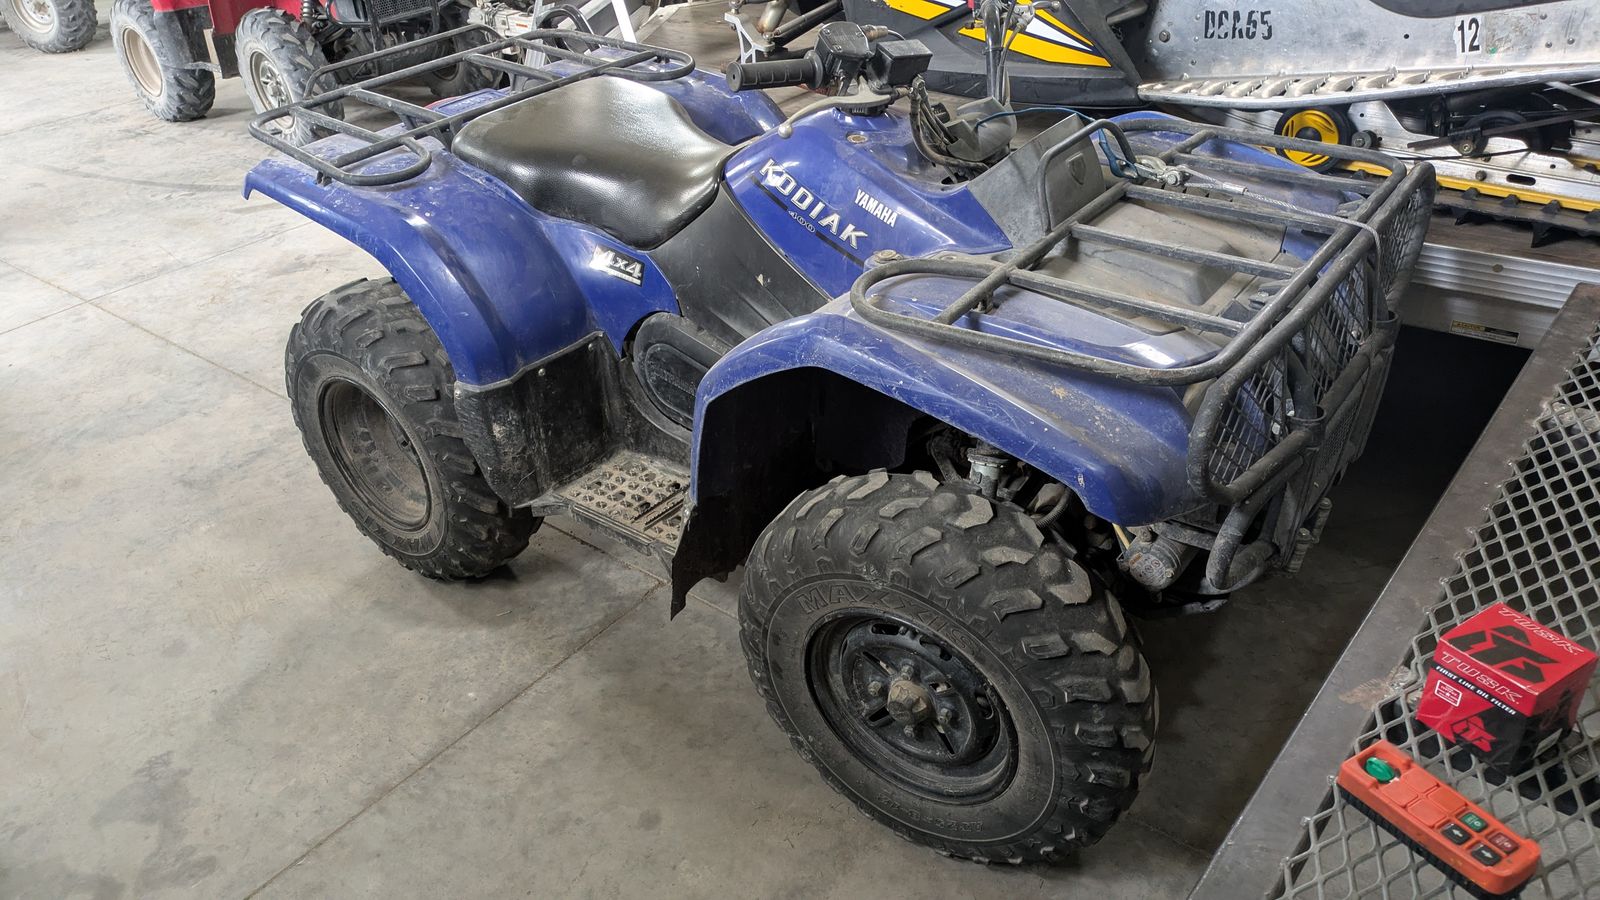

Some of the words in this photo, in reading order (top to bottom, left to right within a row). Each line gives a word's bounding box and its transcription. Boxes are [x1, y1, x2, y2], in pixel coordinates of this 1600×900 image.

[1457, 17, 1480, 53] 12
[759, 158, 869, 250] KODIAK
[787, 210, 816, 233] 400
[854, 188, 898, 228] YAMAHA
[797, 583, 975, 655] MAXXIS
[1498, 606, 1585, 656] TUSK
[1435, 665, 1458, 680] FIRST
[1458, 679, 1476, 691] LINE
[1476, 689, 1490, 699] OIL
[1490, 697, 1517, 715] FILTER
[1442, 651, 1523, 705] TUSK
